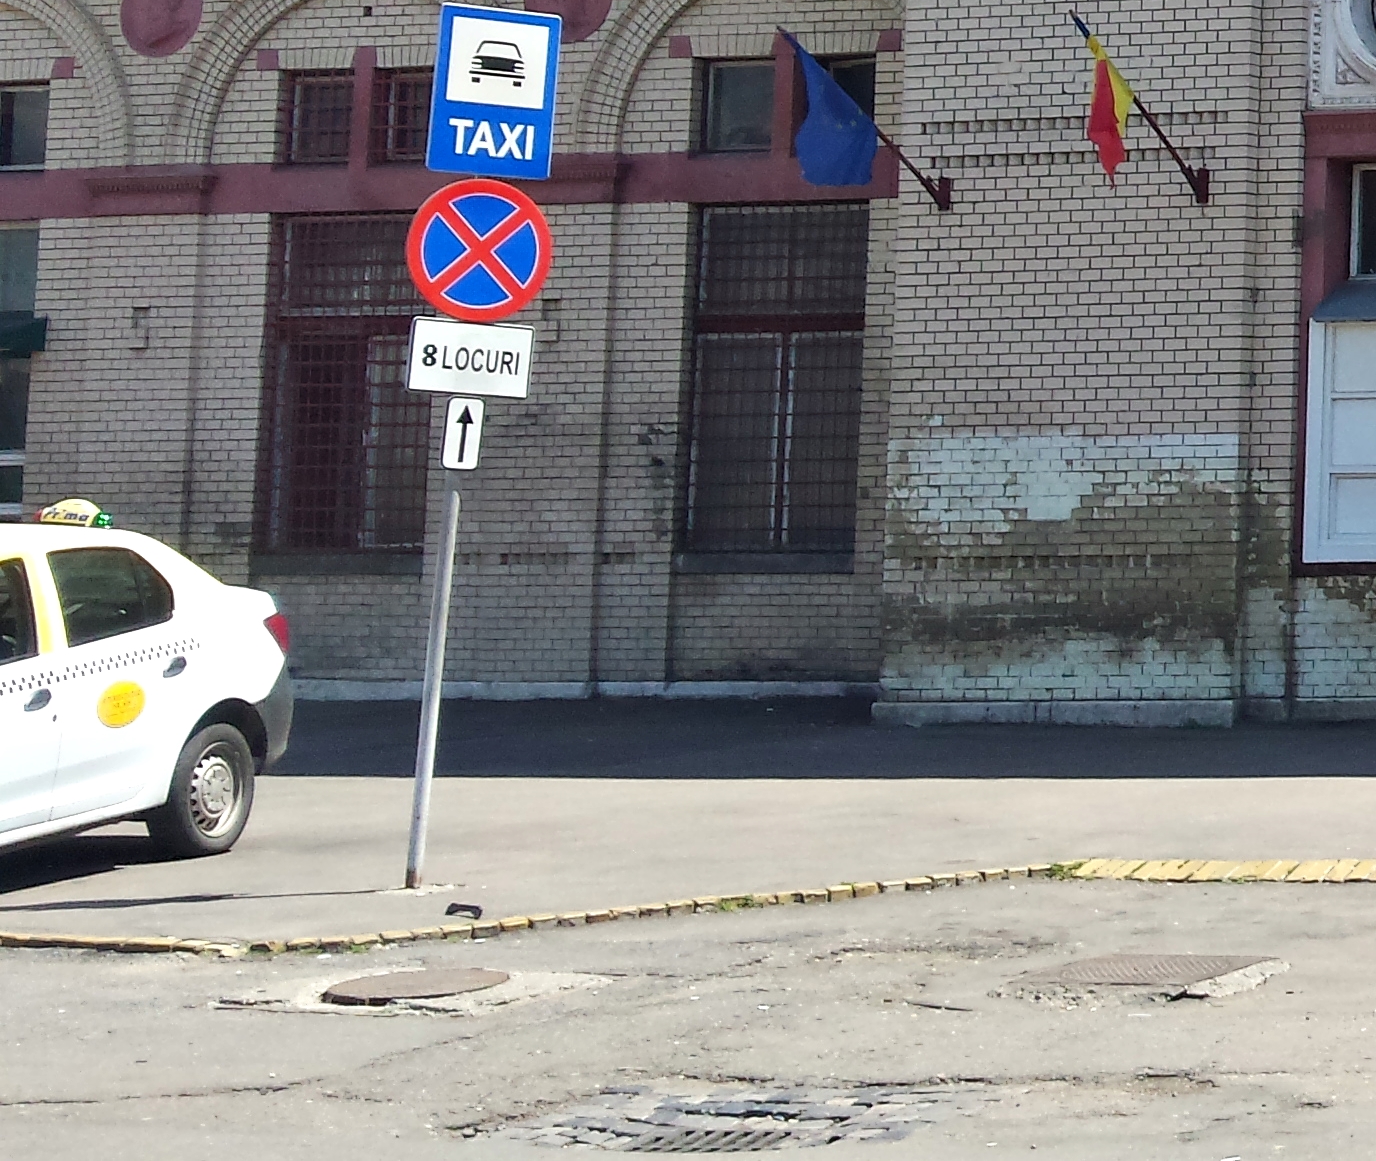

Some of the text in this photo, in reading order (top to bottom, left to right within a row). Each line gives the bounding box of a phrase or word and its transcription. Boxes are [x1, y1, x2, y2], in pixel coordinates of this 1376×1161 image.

[449, 118, 535, 161] TAXI
[422, 344, 520, 376] 8 LOCURI
